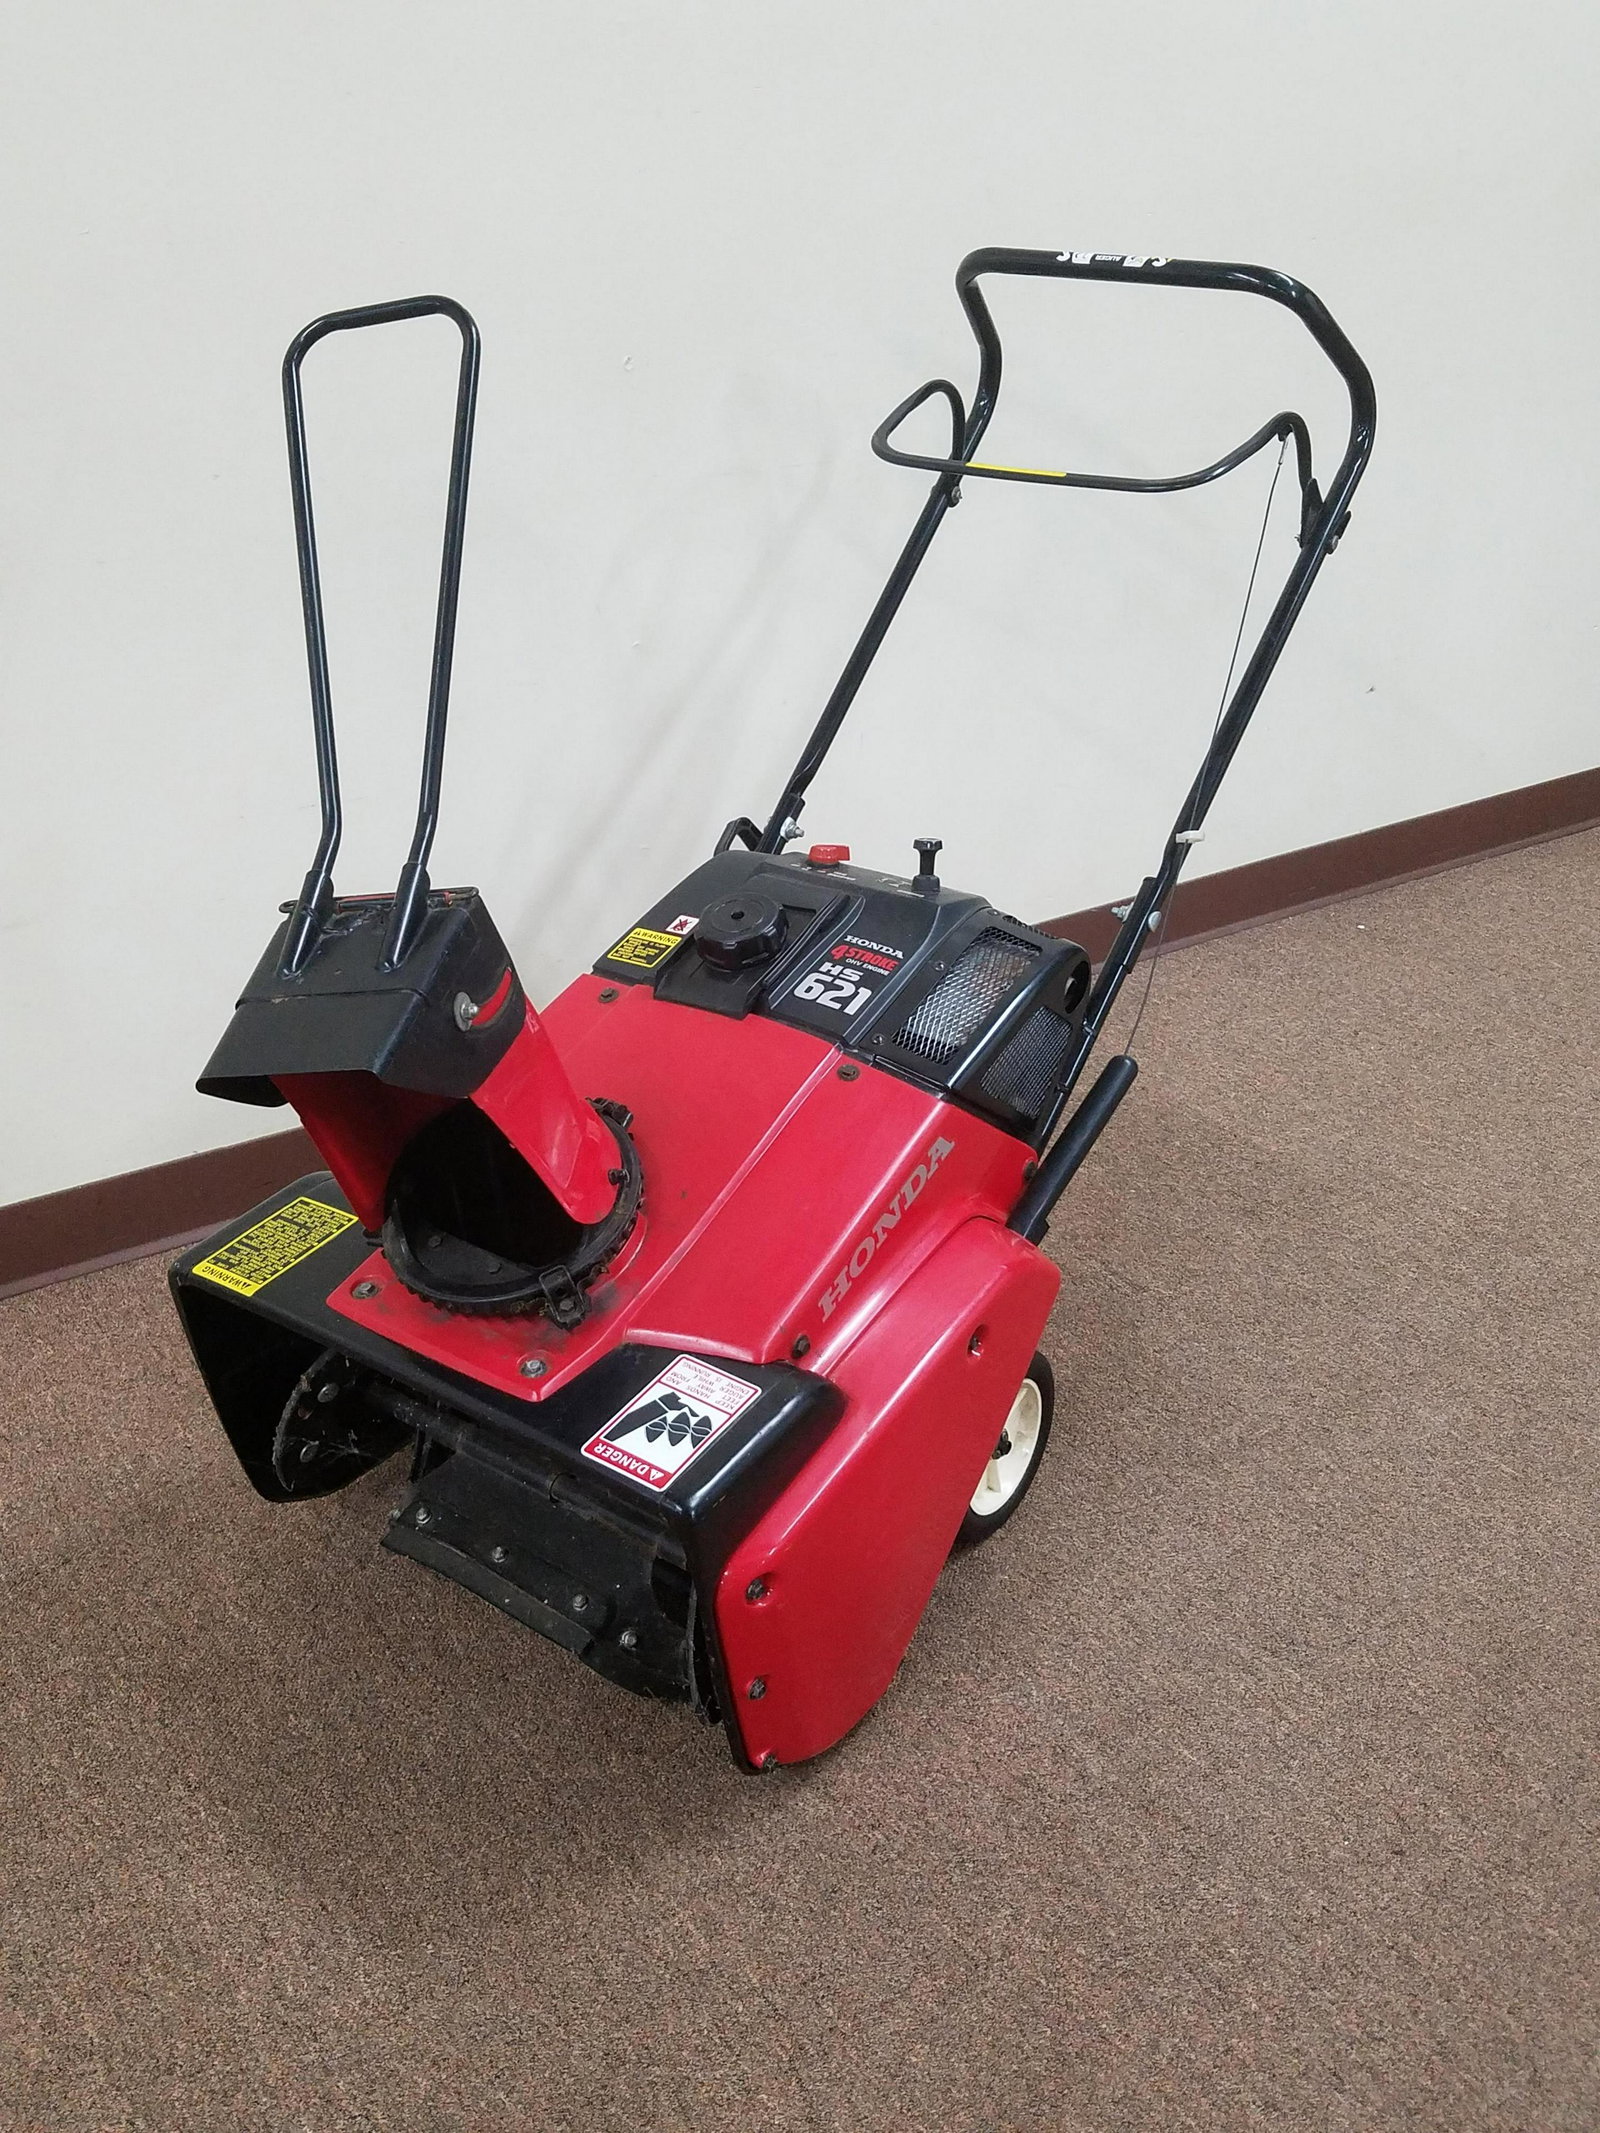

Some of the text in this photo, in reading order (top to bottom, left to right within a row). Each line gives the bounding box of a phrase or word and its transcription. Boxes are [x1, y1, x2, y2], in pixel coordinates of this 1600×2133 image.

[642, 930, 679, 944] WARNING
[843, 935, 904, 959] HONDA
[818, 961, 864, 981] HS
[845, 958, 890, 976] OHV ENGINE
[793, 972, 873, 1016] 621
[818, 1136, 956, 1323] HONDA
[202, 1266, 243, 1288] WARNING
[682, 1361, 711, 1378] RUNNING
[666, 1376, 736, 1410] KEEP HANDS AND
[670, 1372, 741, 1406] FEET AWAY FROM
[694, 1374, 745, 1399] AUGER WHILE
[726, 1382, 750, 1395] ENGINE
[593, 1443, 650, 1476] DANGER
